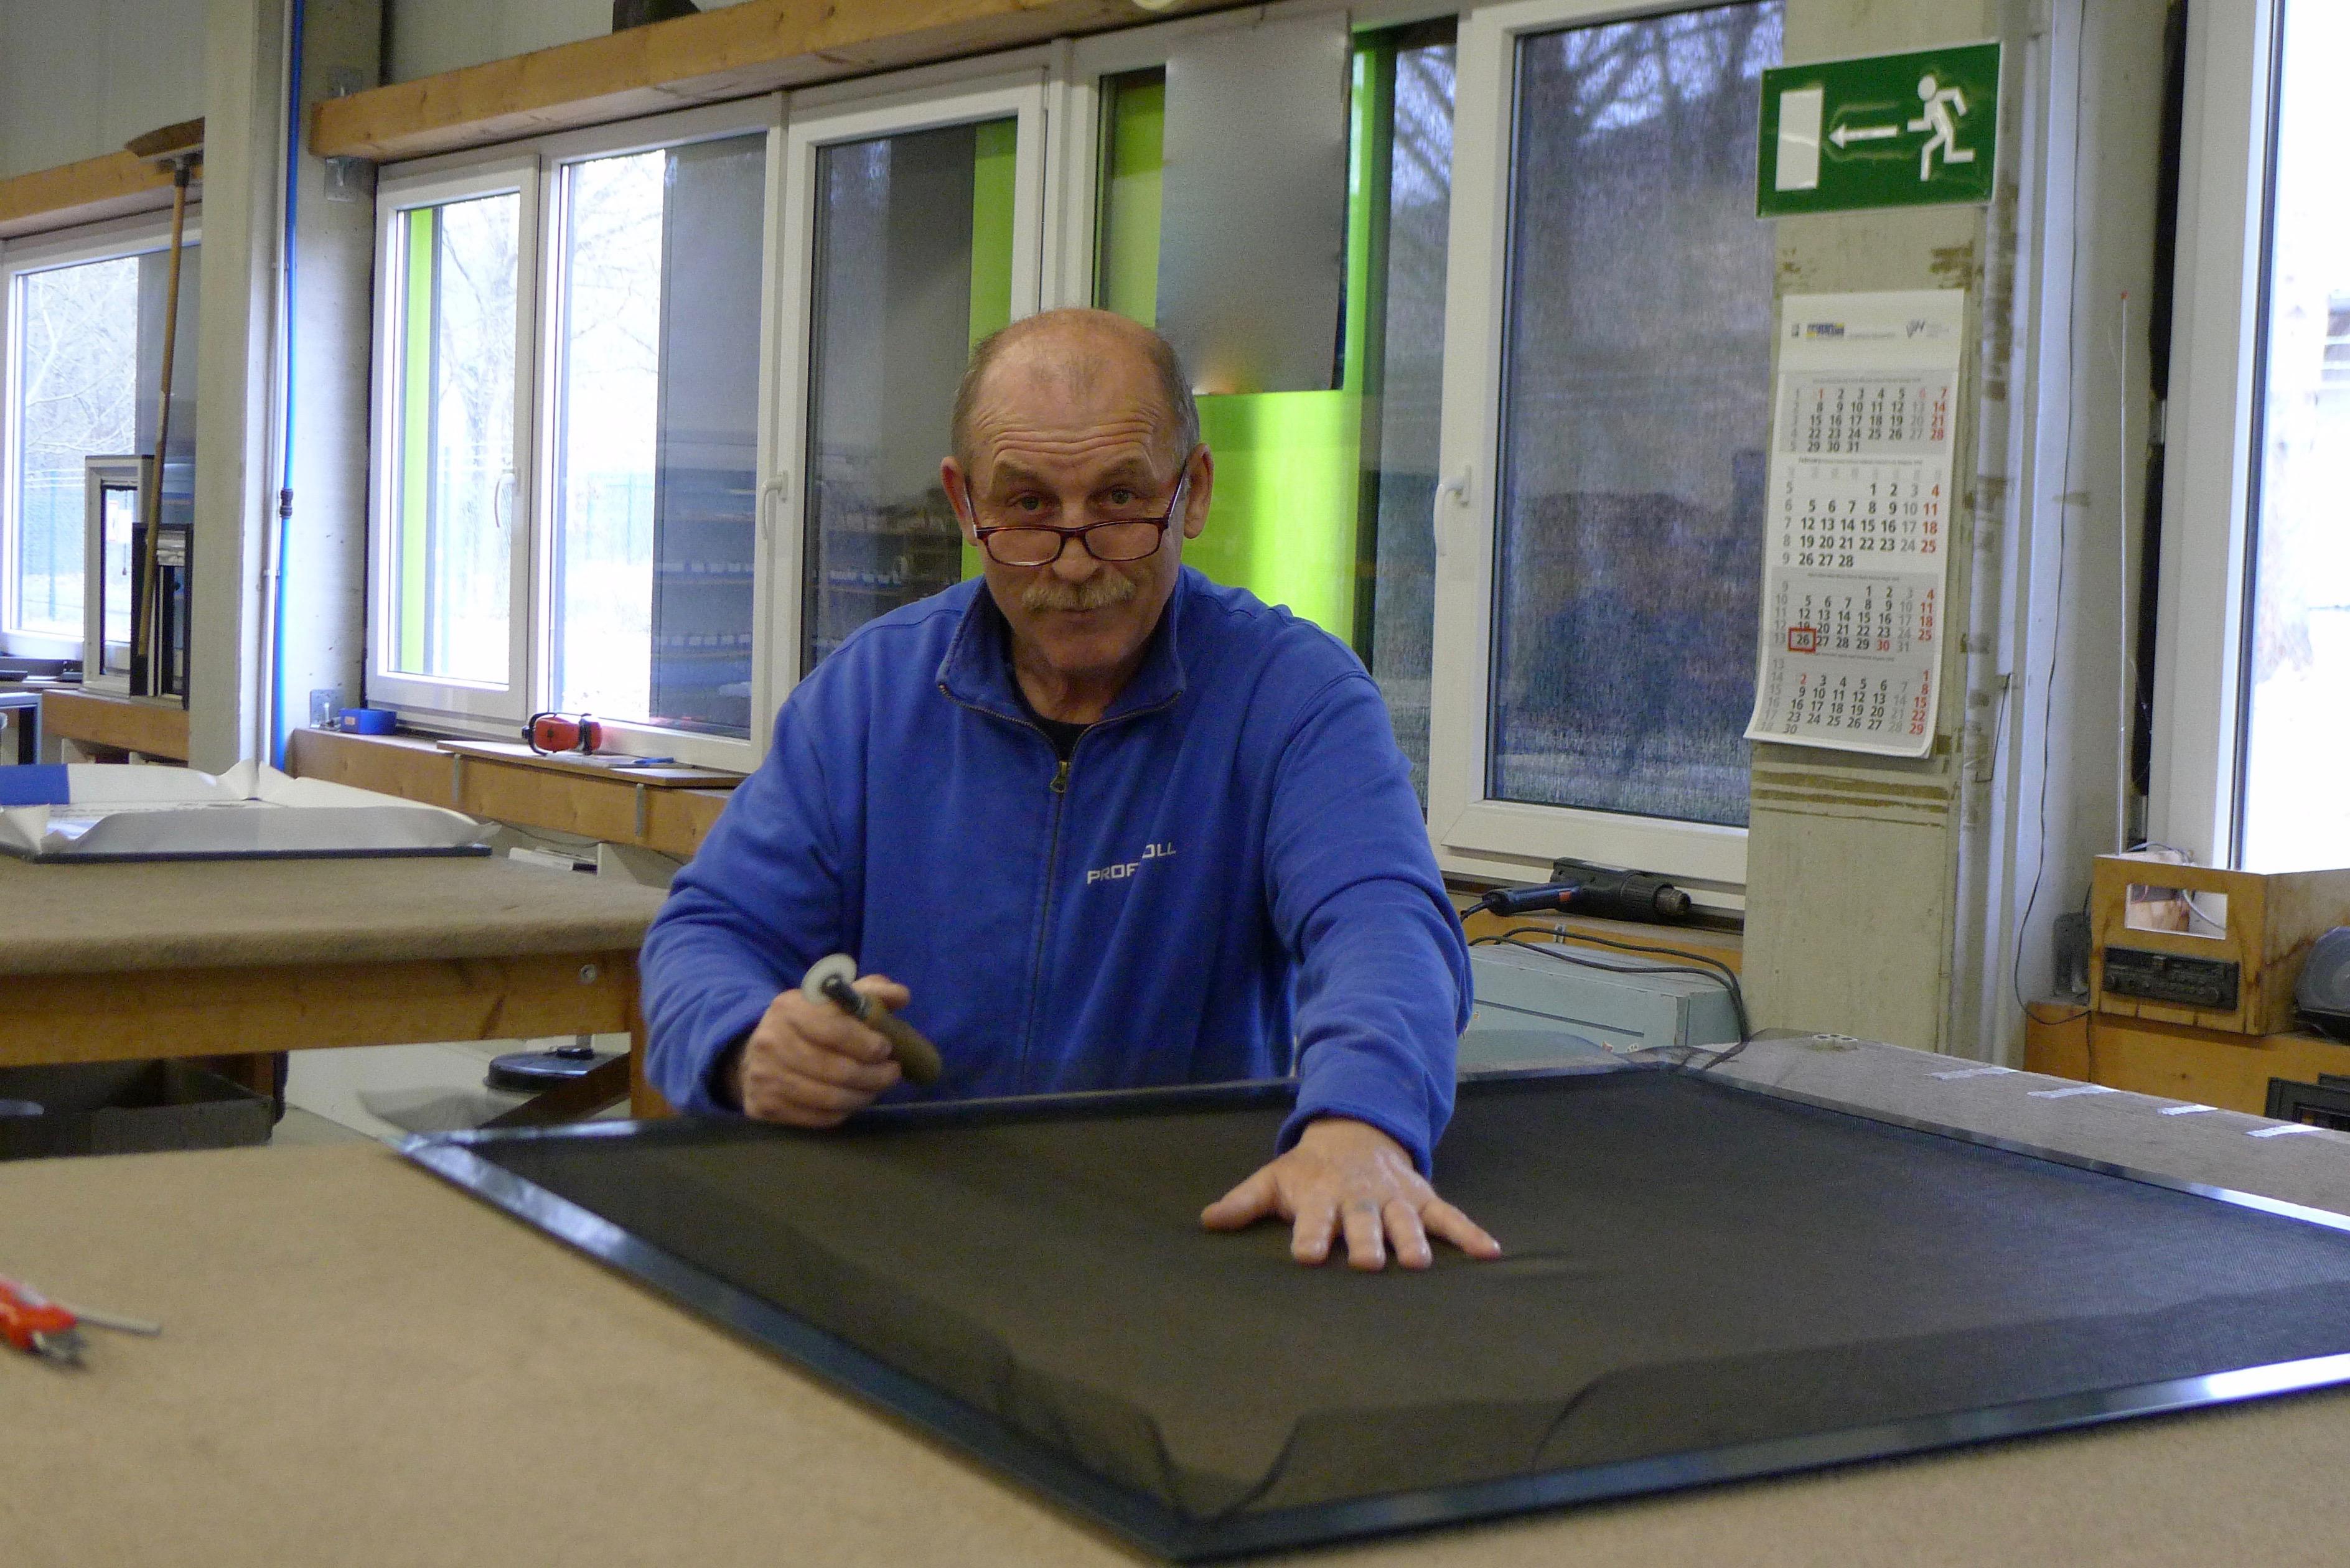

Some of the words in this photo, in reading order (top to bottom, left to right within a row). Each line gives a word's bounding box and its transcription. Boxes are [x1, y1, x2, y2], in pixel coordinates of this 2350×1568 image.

[1819, 388, 1823, 399] 1
[1837, 388, 1844, 399] 2
[1858, 387, 1864, 399] 3
[1878, 387, 1884, 398] 4
[1898, 388, 1904, 399] 5
[1940, 387, 1947, 399] 7
[1816, 401, 1823, 413] 8
[1837, 401, 1843, 413] 9
[1851, 401, 1863, 412] 10
[1871, 401, 1882, 413] 11
[1891, 401, 1903, 413] 12
[1933, 401, 1945, 412] 14
[1810, 414, 1822, 426] 15
[1830, 414, 1842, 426] 16
[1850, 414, 1861, 425] 17
[1870, 415, 1882, 426] 18
[1889, 415, 1903, 426] 19
[1931, 414, 1944, 426] 21
[1808, 427, 1820, 439] 22
[1827, 428, 1841, 439] 23
[1847, 428, 1860, 439] 24
[1868, 428, 1881, 440] 25
[1888, 428, 1902, 441] 26
[1931, 428, 1944, 441] 28
[1807, 441, 1820, 452] 29
[1827, 441, 1840, 452] 30
[1847, 441, 1859, 453] 31
[1786, 481, 1793, 494] 5
[1870, 482, 1876, 496] 1
[1889, 483, 1898, 497] 2
[1911, 483, 1918, 497] 3
[1931, 483, 1940, 497] 4
[1784, 499, 1792, 511] 6
[1809, 499, 1815, 512] 5
[1828, 500, 1836, 513] 6
[1848, 500, 1856, 515] 7
[1868, 500, 1876, 515] 8
[1888, 502, 1897, 515] 9
[1903, 502, 1917, 516] 10
[1923, 502, 1937, 516] 11
[1785, 515, 1792, 530] 7
[1801, 516, 1815, 530] 12
[1821, 517, 1835, 531] 13
[1840, 518, 1855, 532] 14
[1861, 519, 1875, 533] 15
[1881, 519, 1896, 533] 16
[1902, 520, 1917, 534] 17
[1922, 520, 1937, 534] 18
[1783, 533, 1791, 547] 8
[1800, 534, 1814, 548] 19
[1819, 535, 1834, 549] 20
[1838, 536, 1853, 549] 21
[1860, 536, 1875, 551] 22
[1880, 537, 1895, 551] 23
[1900, 538, 1916, 553] 24
[1921, 539, 1937, 553] 25
[1782, 551, 1790, 565] 9
[1799, 552, 1814, 566] 26
[1818, 553, 1833, 567] 27
[1838, 553, 1853, 567] 28
[1866, 586, 1871, 597] 1
[1886, 586, 1893, 598] 2
[1927, 588, 1935, 600] 4
[1805, 594, 1812, 607] 5
[1824, 595, 1831, 608] 6
[1845, 596, 1852, 609] 7
[1865, 598, 1871, 610] 8
[1885, 599, 1893, 612] 9
[1920, 601, 1932, 614] 11
[1798, 607, 1811, 620] 12
[1818, 609, 1831, 621] 13
[1837, 610, 1851, 622] 14
[1858, 612, 1871, 623] 15
[1878, 612, 1891, 625] 16
[1919, 615, 1933, 628] 18
[1817, 622, 1830, 634] 20
[1837, 623, 1850, 636] 21
[1856, 625, 1870, 637] 22
[1876, 626, 1891, 638] 23
[1917, 628, 1932, 642] 25
[1796, 633, 1810, 646] 26
[1816, 635, 1829, 647] 27
[1836, 636, 1850, 649] 28
[1856, 637, 1870, 650] 29
[1876, 638, 1890, 652] 30
[1800, 673, 1807, 685] 2
[1820, 673, 1827, 686] 3
[1839, 675, 1847, 688] 4
[1859, 676, 1866, 690] 5
[1880, 679, 1888, 691] 6
[1921, 683, 1929, 696] 8
[1923, 670, 1929, 682] 1
[1799, 686, 1806, 698] 9
[1813, 687, 1826, 699] 10
[1833, 689, 1845, 701] 11
[1853, 691, 1865, 703] 12
[1873, 692, 1886, 705] 13
[1914, 696, 1927, 709] 15
[1791, 698, 1804, 711] 16
[1811, 700, 1824, 712] 17
[1831, 702, 1844, 714] 18
[1850, 704, 1864, 716] 19
[1870, 706, 1884, 718] 20
[1911, 709, 1926, 722] 22
[1782, 723, 1798, 735] 30
[1787, 711, 1802, 723] 23
[1807, 712, 1821, 725] 24
[1827, 715, 1842, 727] 25
[1847, 717, 1861, 729] 26
[1867, 719, 1883, 731] 27
[1908, 722, 1924, 735] 29
